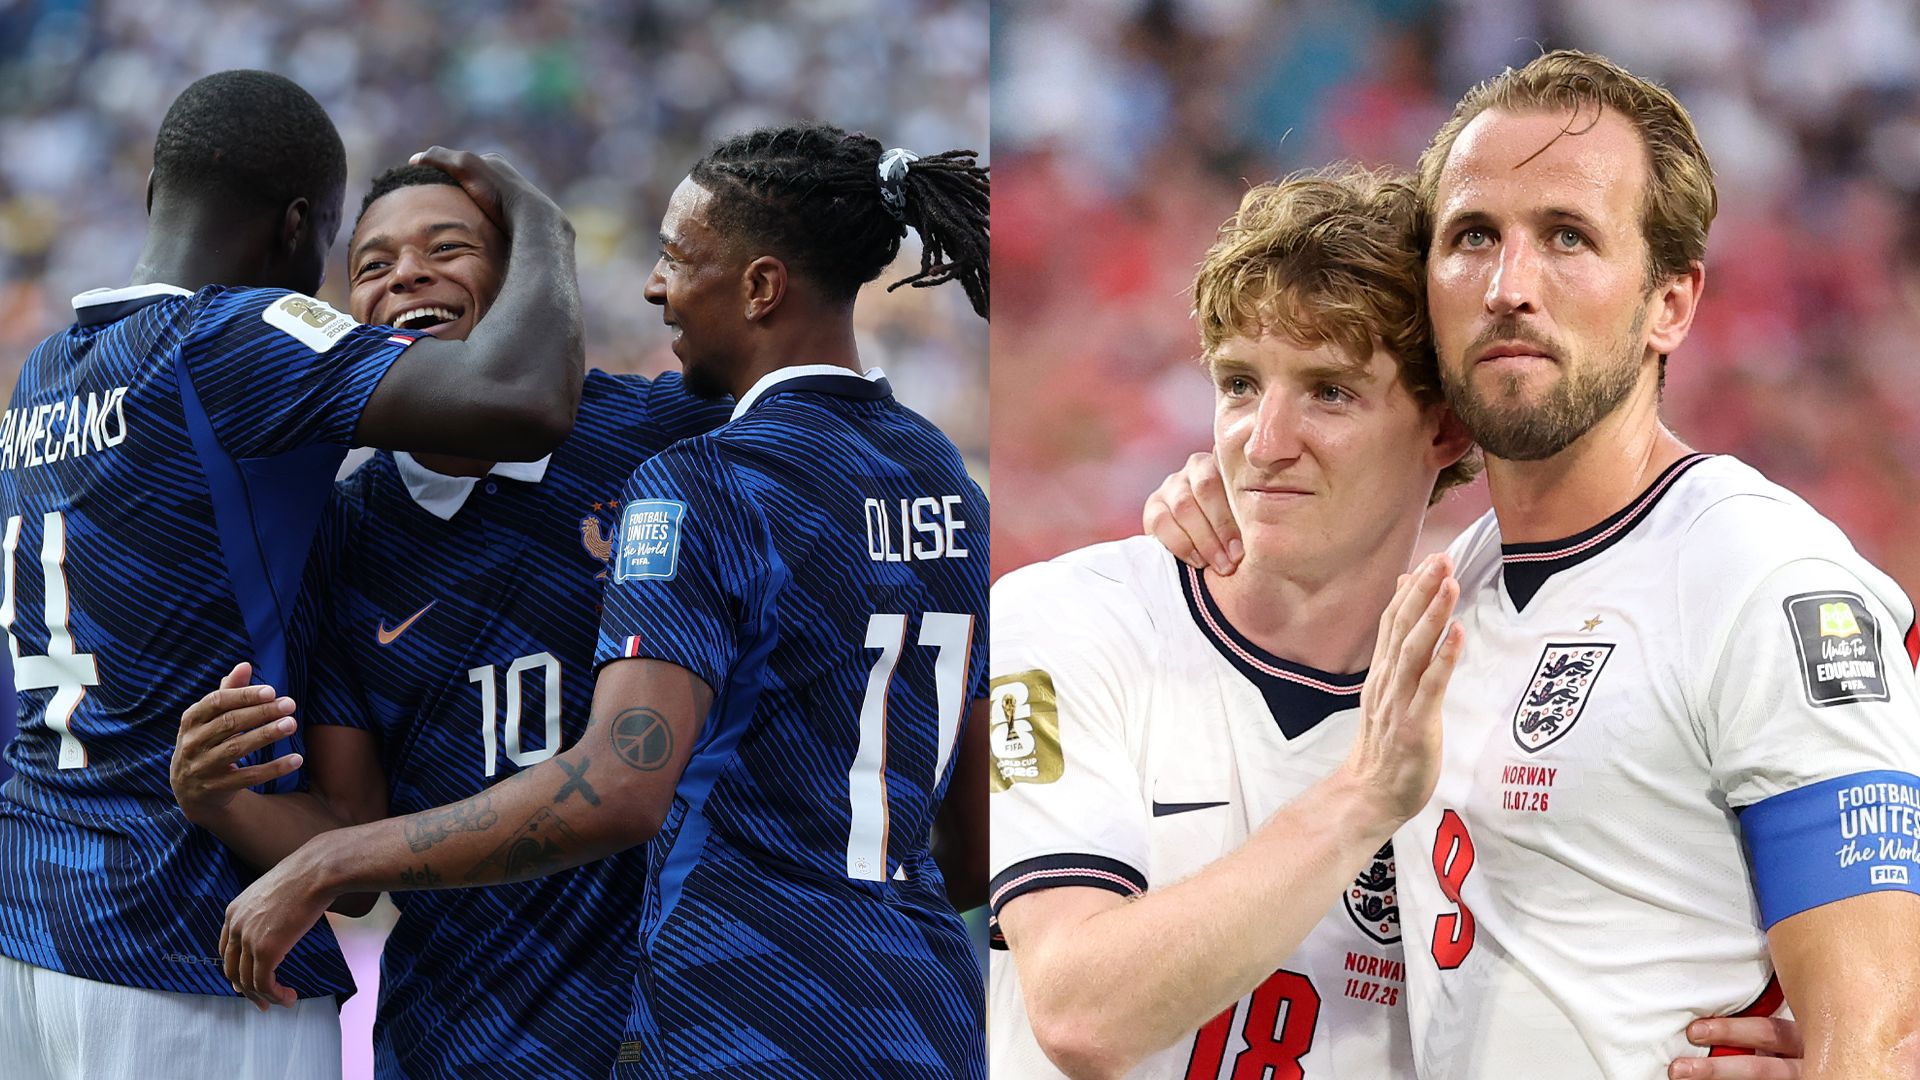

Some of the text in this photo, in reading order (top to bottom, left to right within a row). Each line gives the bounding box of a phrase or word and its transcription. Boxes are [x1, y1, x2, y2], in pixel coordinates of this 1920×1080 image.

[326, 321, 352, 338] 2026
[629, 511, 670, 526] FOOTBALL
[864, 495, 969, 562] OLISE
[627, 524, 669, 542] UNITES
[623, 541, 670, 559] the World
[0, 511, 100, 770] 4
[1821, 638, 1867, 661] Unite For
[1816, 660, 1876, 682] EDUCATION
[468, 651, 563, 777] 10
[846, 611, 975, 882] 11
[1004, 742, 1023, 751] FIFA
[1020, 757, 1038, 767] CUP
[1501, 765, 1557, 787] NORWAY
[1503, 791, 1549, 812] 11.07.26
[1840, 804, 1920, 840] UNITES
[1835, 839, 1876, 869] the
[1874, 868, 1905, 880] FIFA
[1431, 808, 1476, 970] 9
[1344, 978, 1399, 1006] 11.07.26
[1183, 968, 1322, 1080] 18
